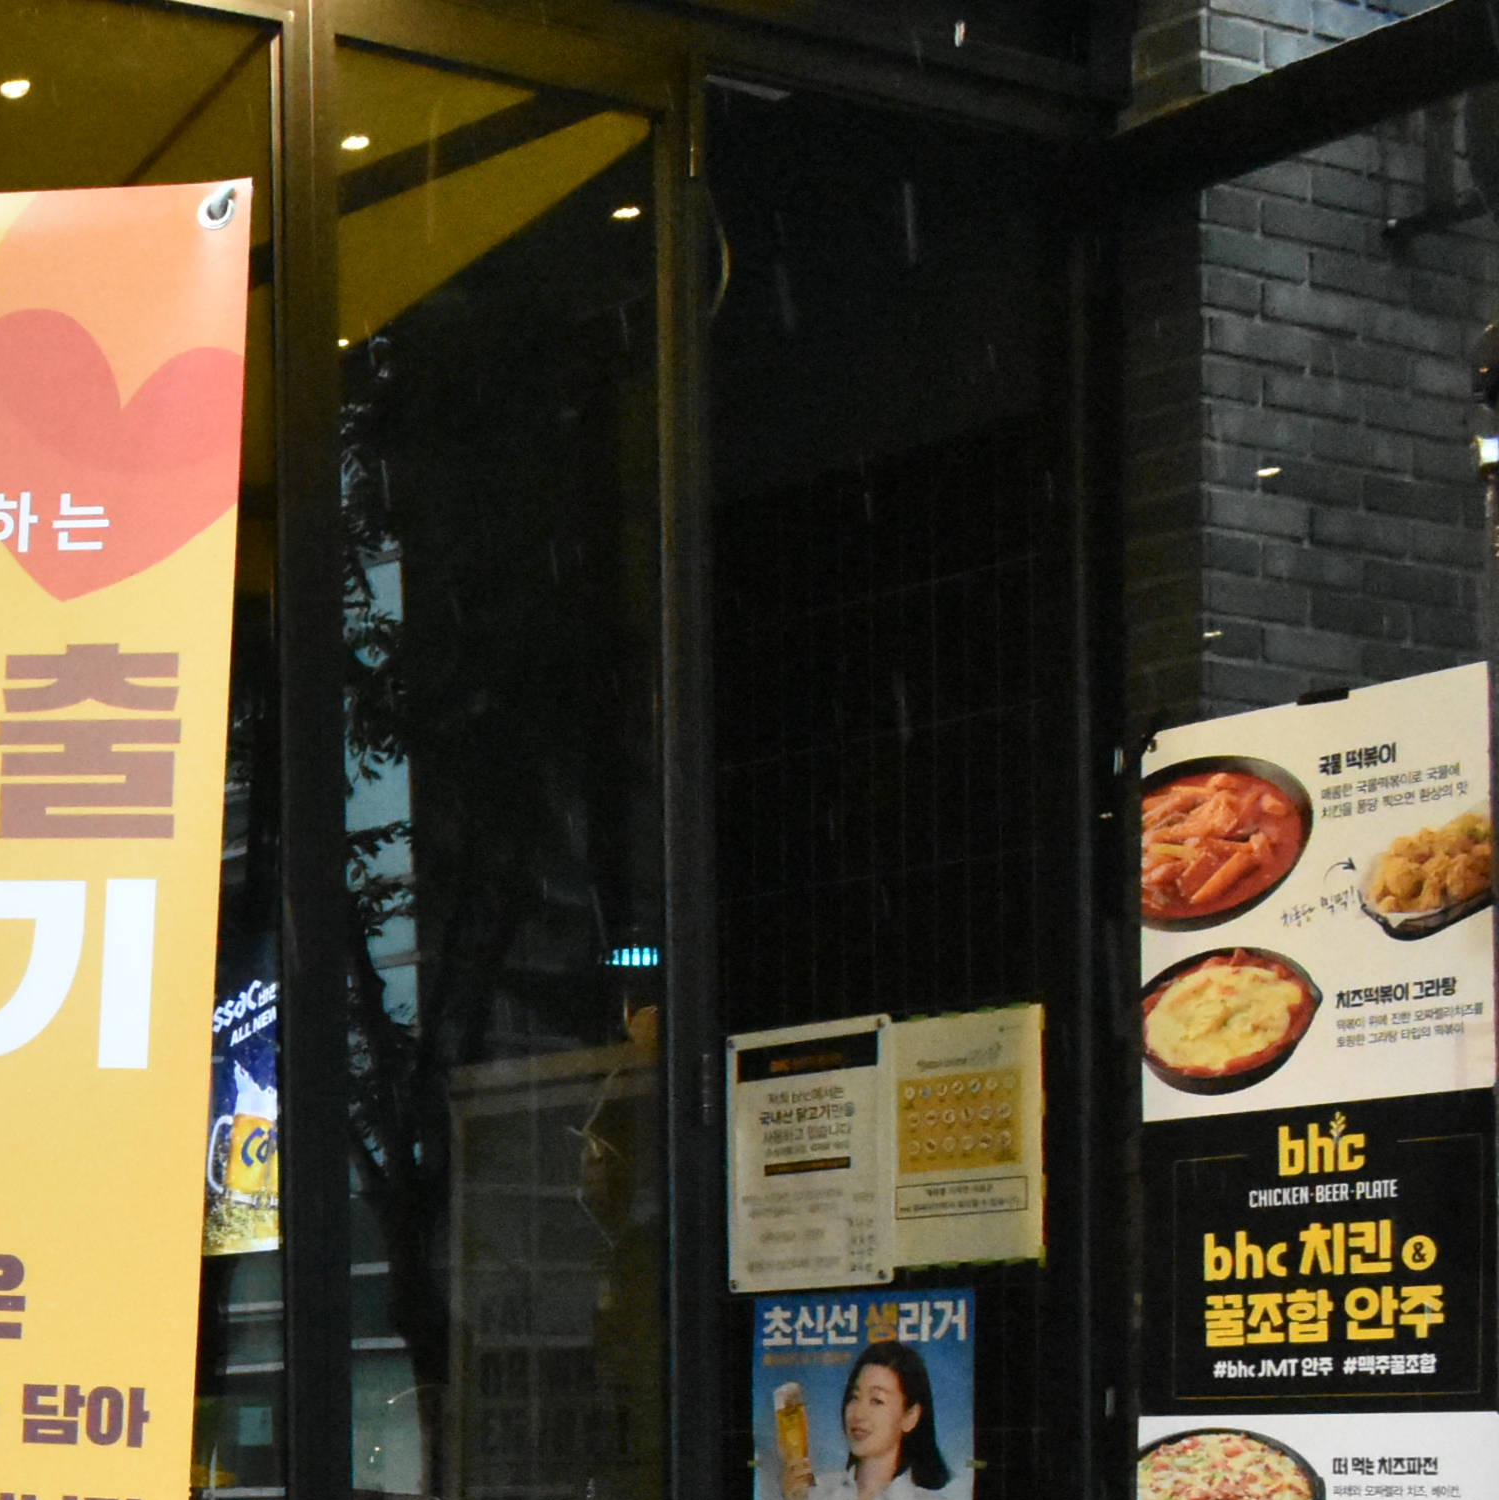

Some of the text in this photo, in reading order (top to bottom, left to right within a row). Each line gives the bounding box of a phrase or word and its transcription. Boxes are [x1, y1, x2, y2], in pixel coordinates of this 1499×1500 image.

[1345, 742, 1397, 770] 떡볶이
[1335, 976, 1457, 1009] 치즈떡볶이 그라탕
[229, 1021, 252, 1047] ALL
[1278, 1122, 1366, 1177] bhc
[1203, 1230, 1288, 1282] bhc
[1299, 1218, 1393, 1276] 치킨
[762, 1304, 860, 1347] 초신선
[1204, 1284, 1445, 1348] 꿀조합 안주
[1213, 1359, 1255, 1379] #bhc
[1257, 1358, 1299, 1378] JMT
[1301, 1356, 1334, 1377] 안주
[21, 1383, 150, 1449] 담아
[1377, 1456, 1439, 1476] 치즈파전
